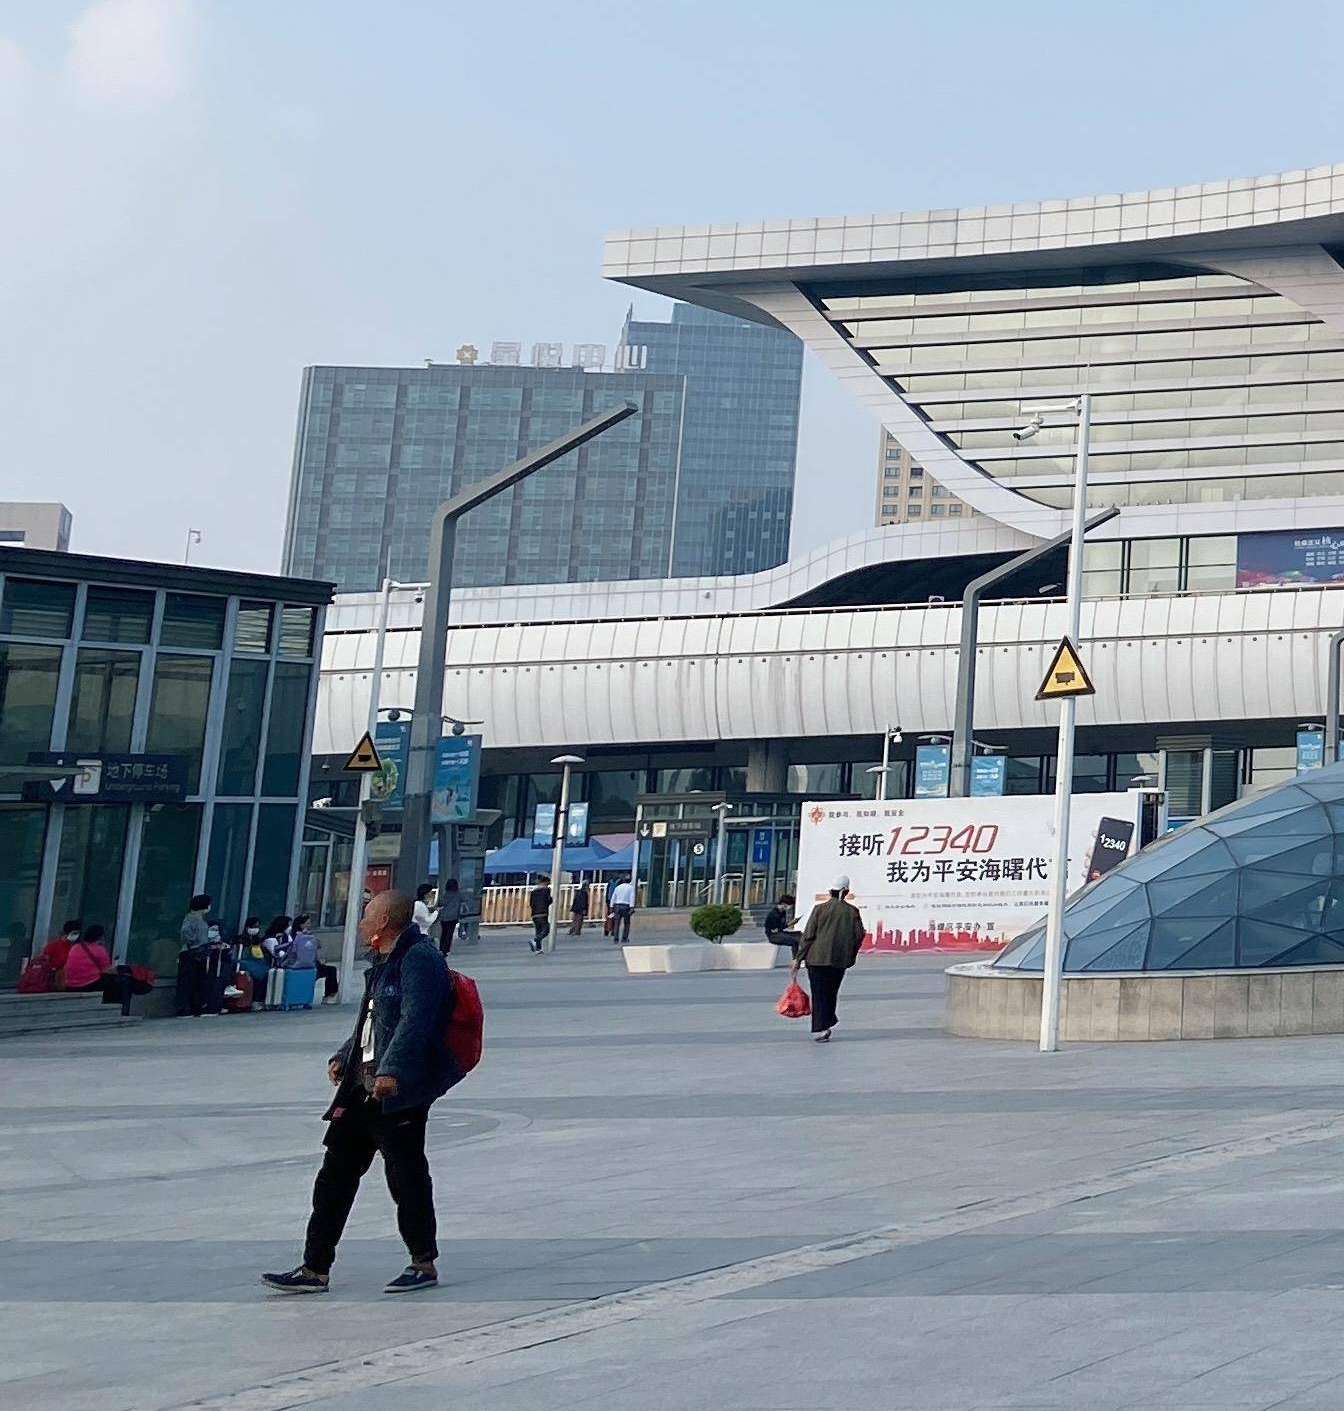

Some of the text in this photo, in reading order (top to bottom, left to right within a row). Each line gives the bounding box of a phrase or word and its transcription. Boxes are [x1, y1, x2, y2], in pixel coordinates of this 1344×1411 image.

[107, 763, 169, 779] 地下停车场
[839, 824, 999, 856] 接听12340
[1099, 833, 1126, 851] 12340
[886, 857, 1072, 883] 我为平安海曙代
